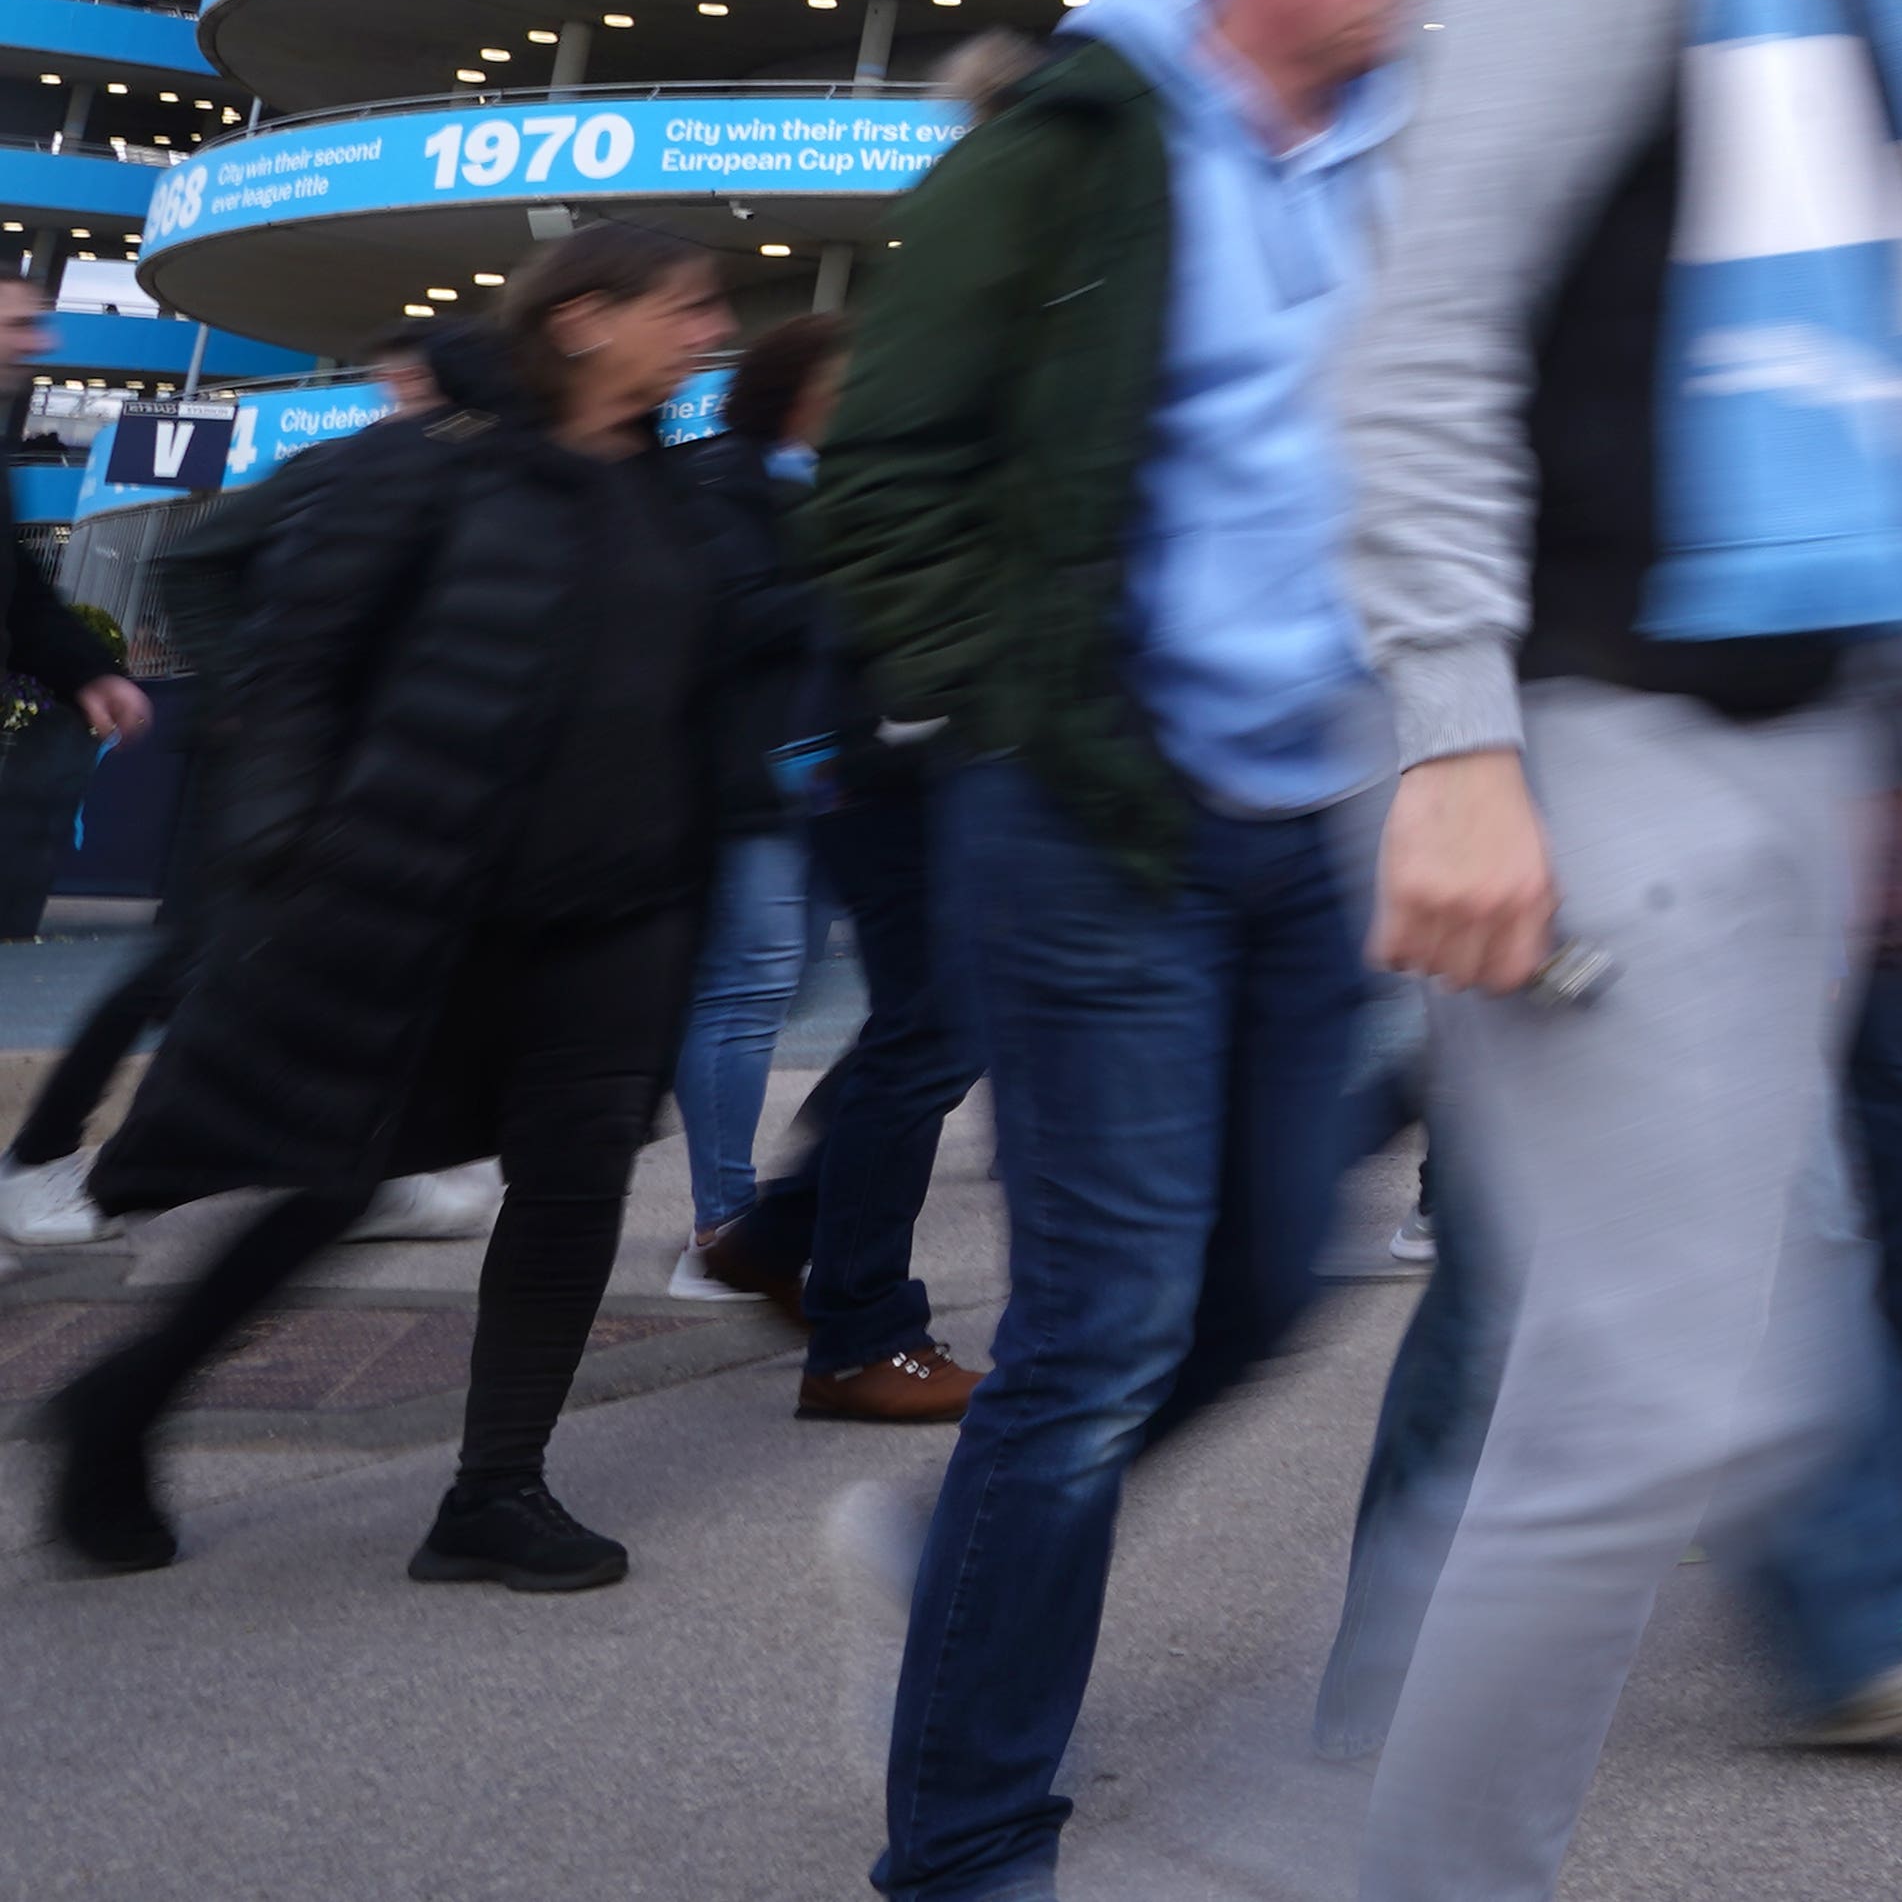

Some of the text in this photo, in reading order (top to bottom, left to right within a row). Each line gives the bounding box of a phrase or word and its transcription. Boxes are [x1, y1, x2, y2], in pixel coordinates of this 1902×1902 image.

[665, 116, 911, 146] City win their first
[312, 136, 382, 168] second
[423, 112, 636, 190] 1970
[661, 146, 856, 176] European Cup
[294, 174, 330, 199] title
[280, 408, 321, 436] City
[153, 419, 196, 479] V
